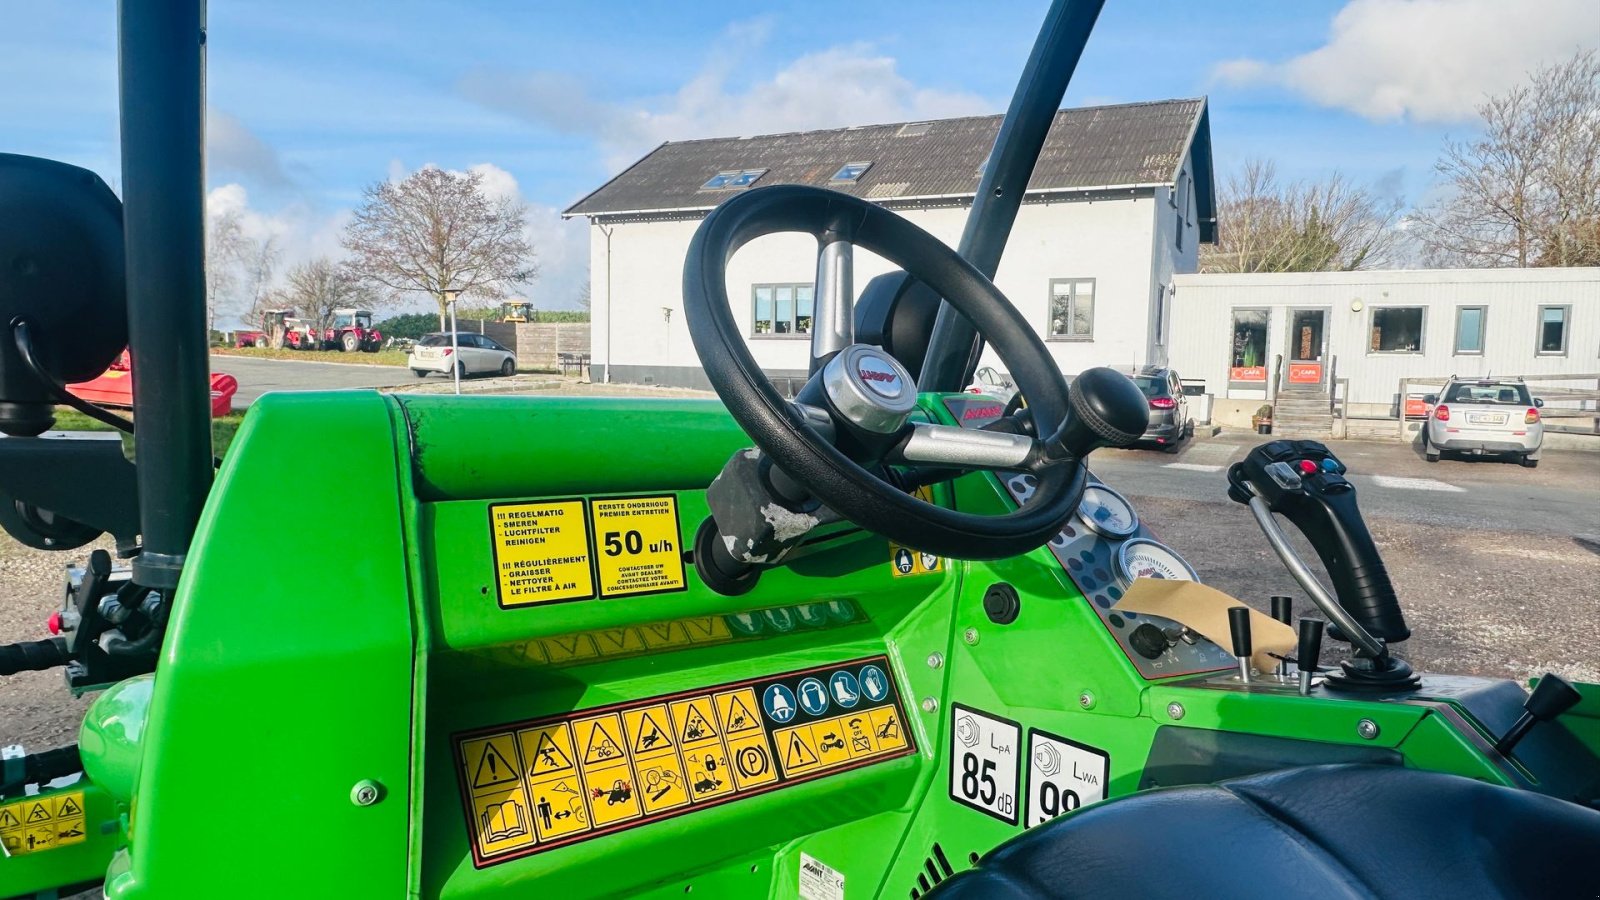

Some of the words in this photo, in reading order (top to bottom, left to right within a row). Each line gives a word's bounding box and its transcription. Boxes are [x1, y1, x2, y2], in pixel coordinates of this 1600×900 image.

[508, 509, 564, 519] REGELMATIG
[599, 510, 630, 518] PREMIER
[504, 520, 538, 528] SMEREN
[504, 527, 560, 537] LUCHTFILTER
[505, 537, 546, 546] REINIGEN
[604, 530, 643, 557] 50
[649, 539, 673, 553] u/h
[514, 555, 586, 569] RÉGULIÈREMENT
[509, 568, 551, 578] GRAISSER
[510, 576, 554, 587] NETTOYER
[523, 585, 552, 594] FILTRE
[962, 752, 996, 806] 85
[997, 792, 1013, 815] dB
[802, 862, 824, 878] AVANT
